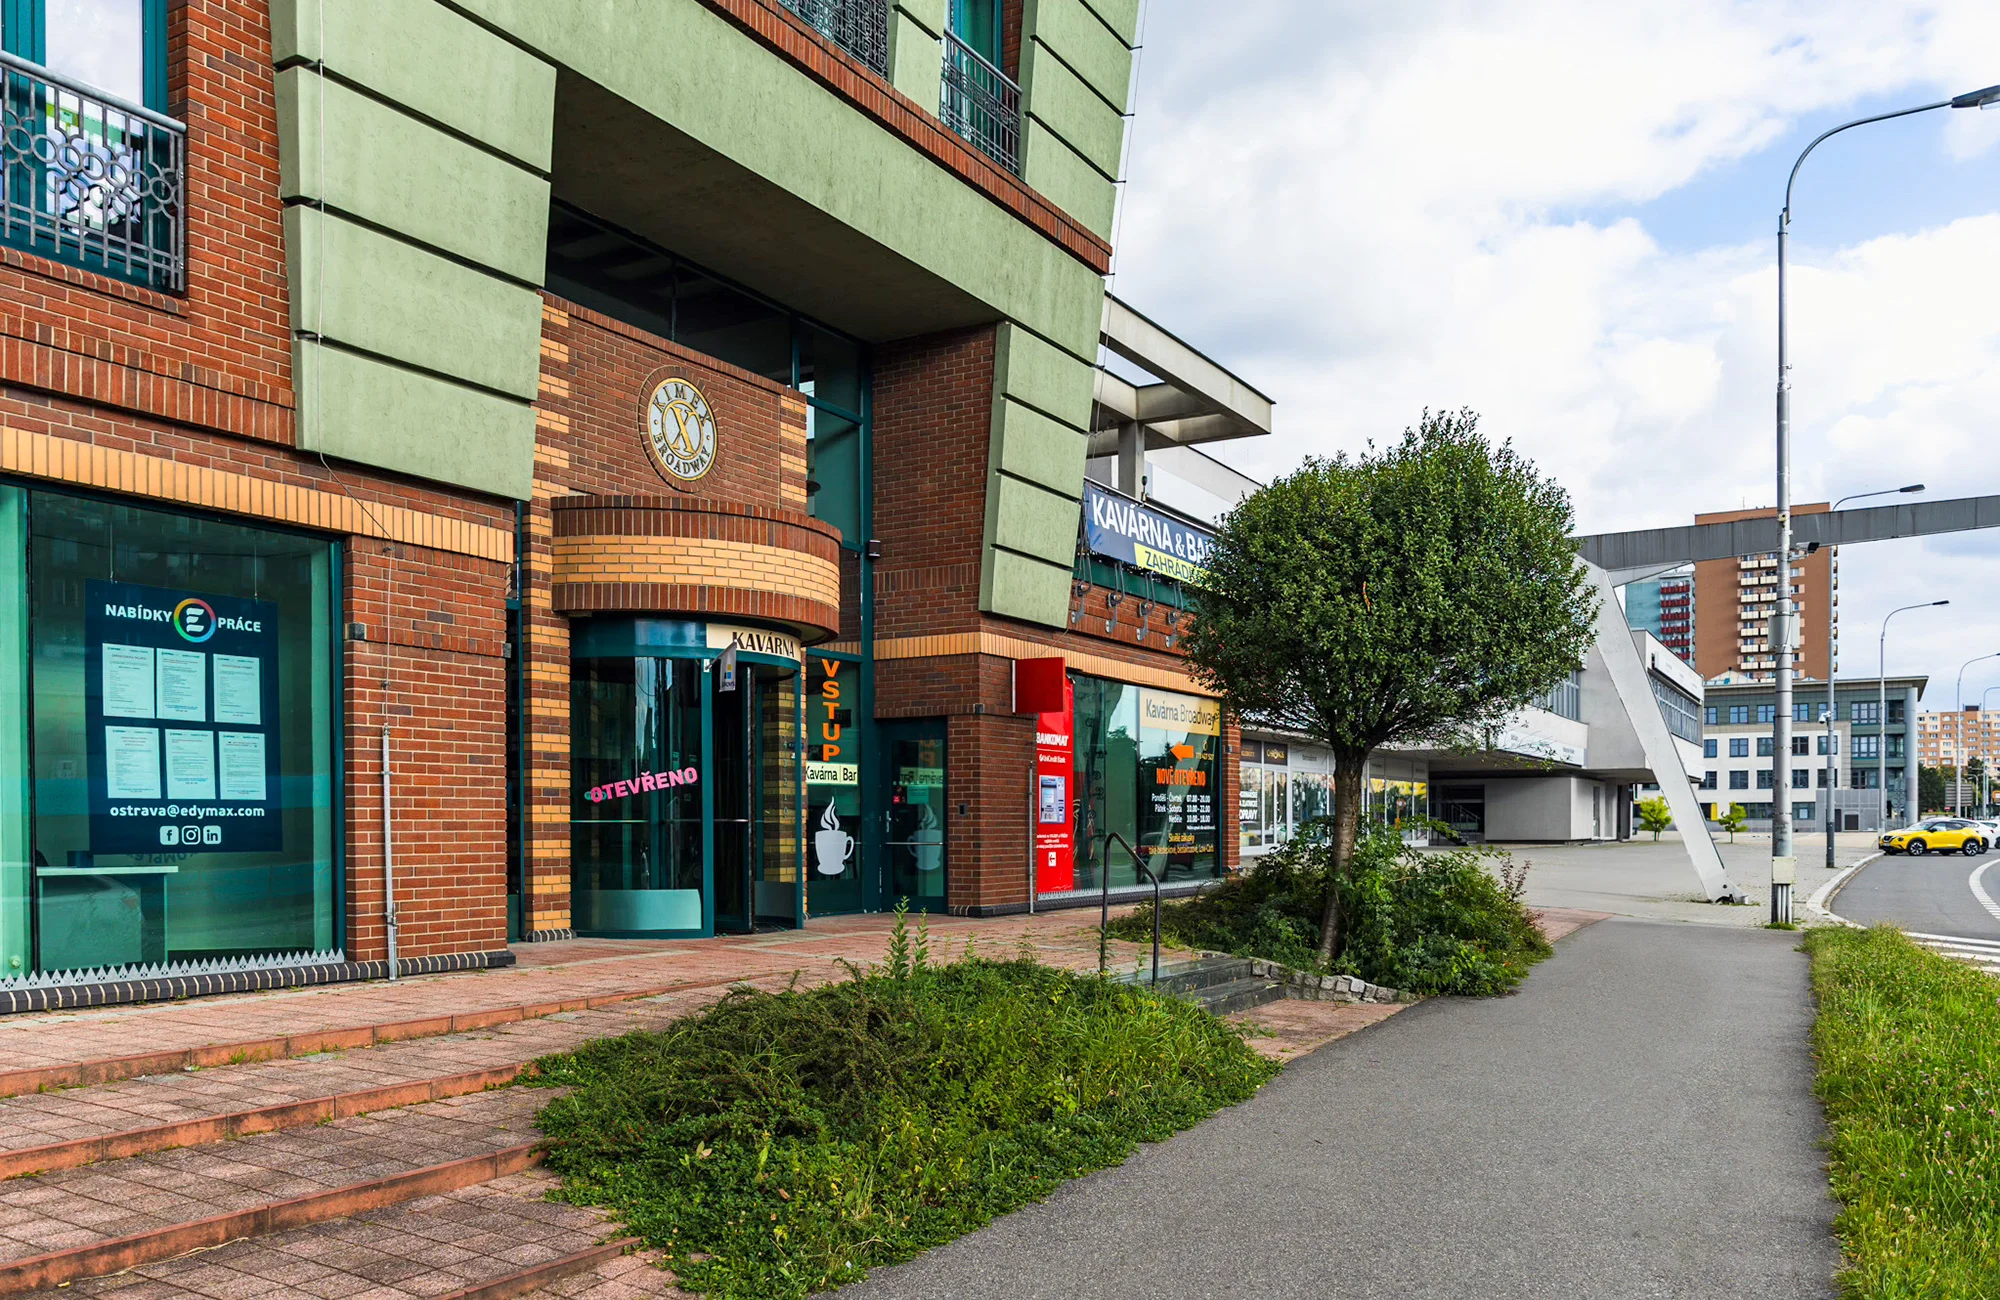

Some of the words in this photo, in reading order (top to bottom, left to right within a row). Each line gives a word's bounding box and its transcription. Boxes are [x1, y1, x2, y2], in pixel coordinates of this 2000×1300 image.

[653, 383, 712, 427] KIMEX
[653, 432, 711, 474] BROADWAY
[1092, 493, 1174, 553] KAVÁRNA
[1175, 532, 1186, 557] &
[105, 603, 173, 623] NABÍDKY
[217, 615, 262, 633] PRÁCE
[732, 631, 795, 658] KAVÁRNA
[821, 658, 841, 762] VSTUP
[1146, 698, 1179, 722] Kavárna
[1180, 704, 1216, 731] Broadway
[1036, 731, 1069, 747] BANKOMAT
[590, 766, 698, 804] OTEVŘENO
[843, 767, 857, 781] Bar
[1157, 766, 1173, 785] NOVĚ
[1174, 768, 1206, 787] OTEVŘENO
[110, 804, 265, 819] ostrava@edymax.com
